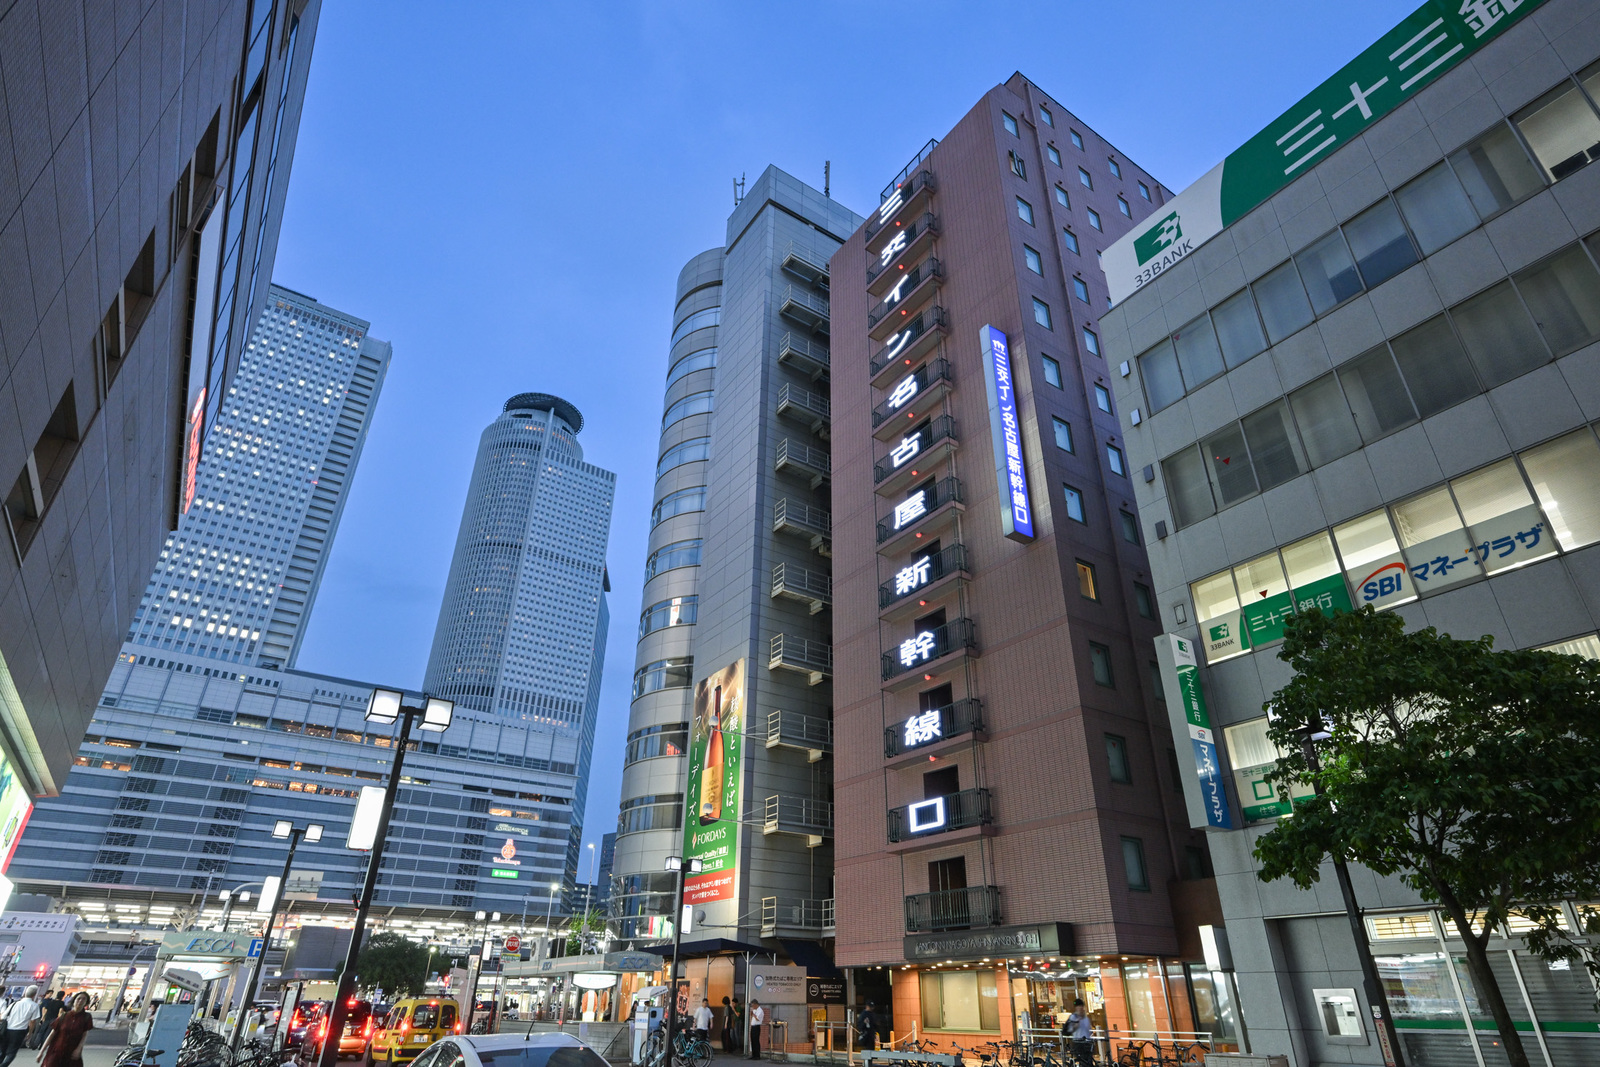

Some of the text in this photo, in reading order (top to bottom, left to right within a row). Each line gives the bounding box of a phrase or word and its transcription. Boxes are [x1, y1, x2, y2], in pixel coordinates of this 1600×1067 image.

[1134, 238, 1194, 289] 33BANK
[879, 188, 945, 833] 三交イン名古屋新幹線口
[1363, 521, 1545, 602] SBI マネープラザ
[1209, 637, 1235, 652] 33BANK
[1185, 670, 1202, 723] 三十三銀行
[1241, 765, 1275, 778] 三十三銀行
[1260, 805, 1277, 816] 住宅
[697, 827, 727, 845] FORDAYS
[184, 937, 236, 954] ESCA
[618, 956, 650, 970] ESCA
